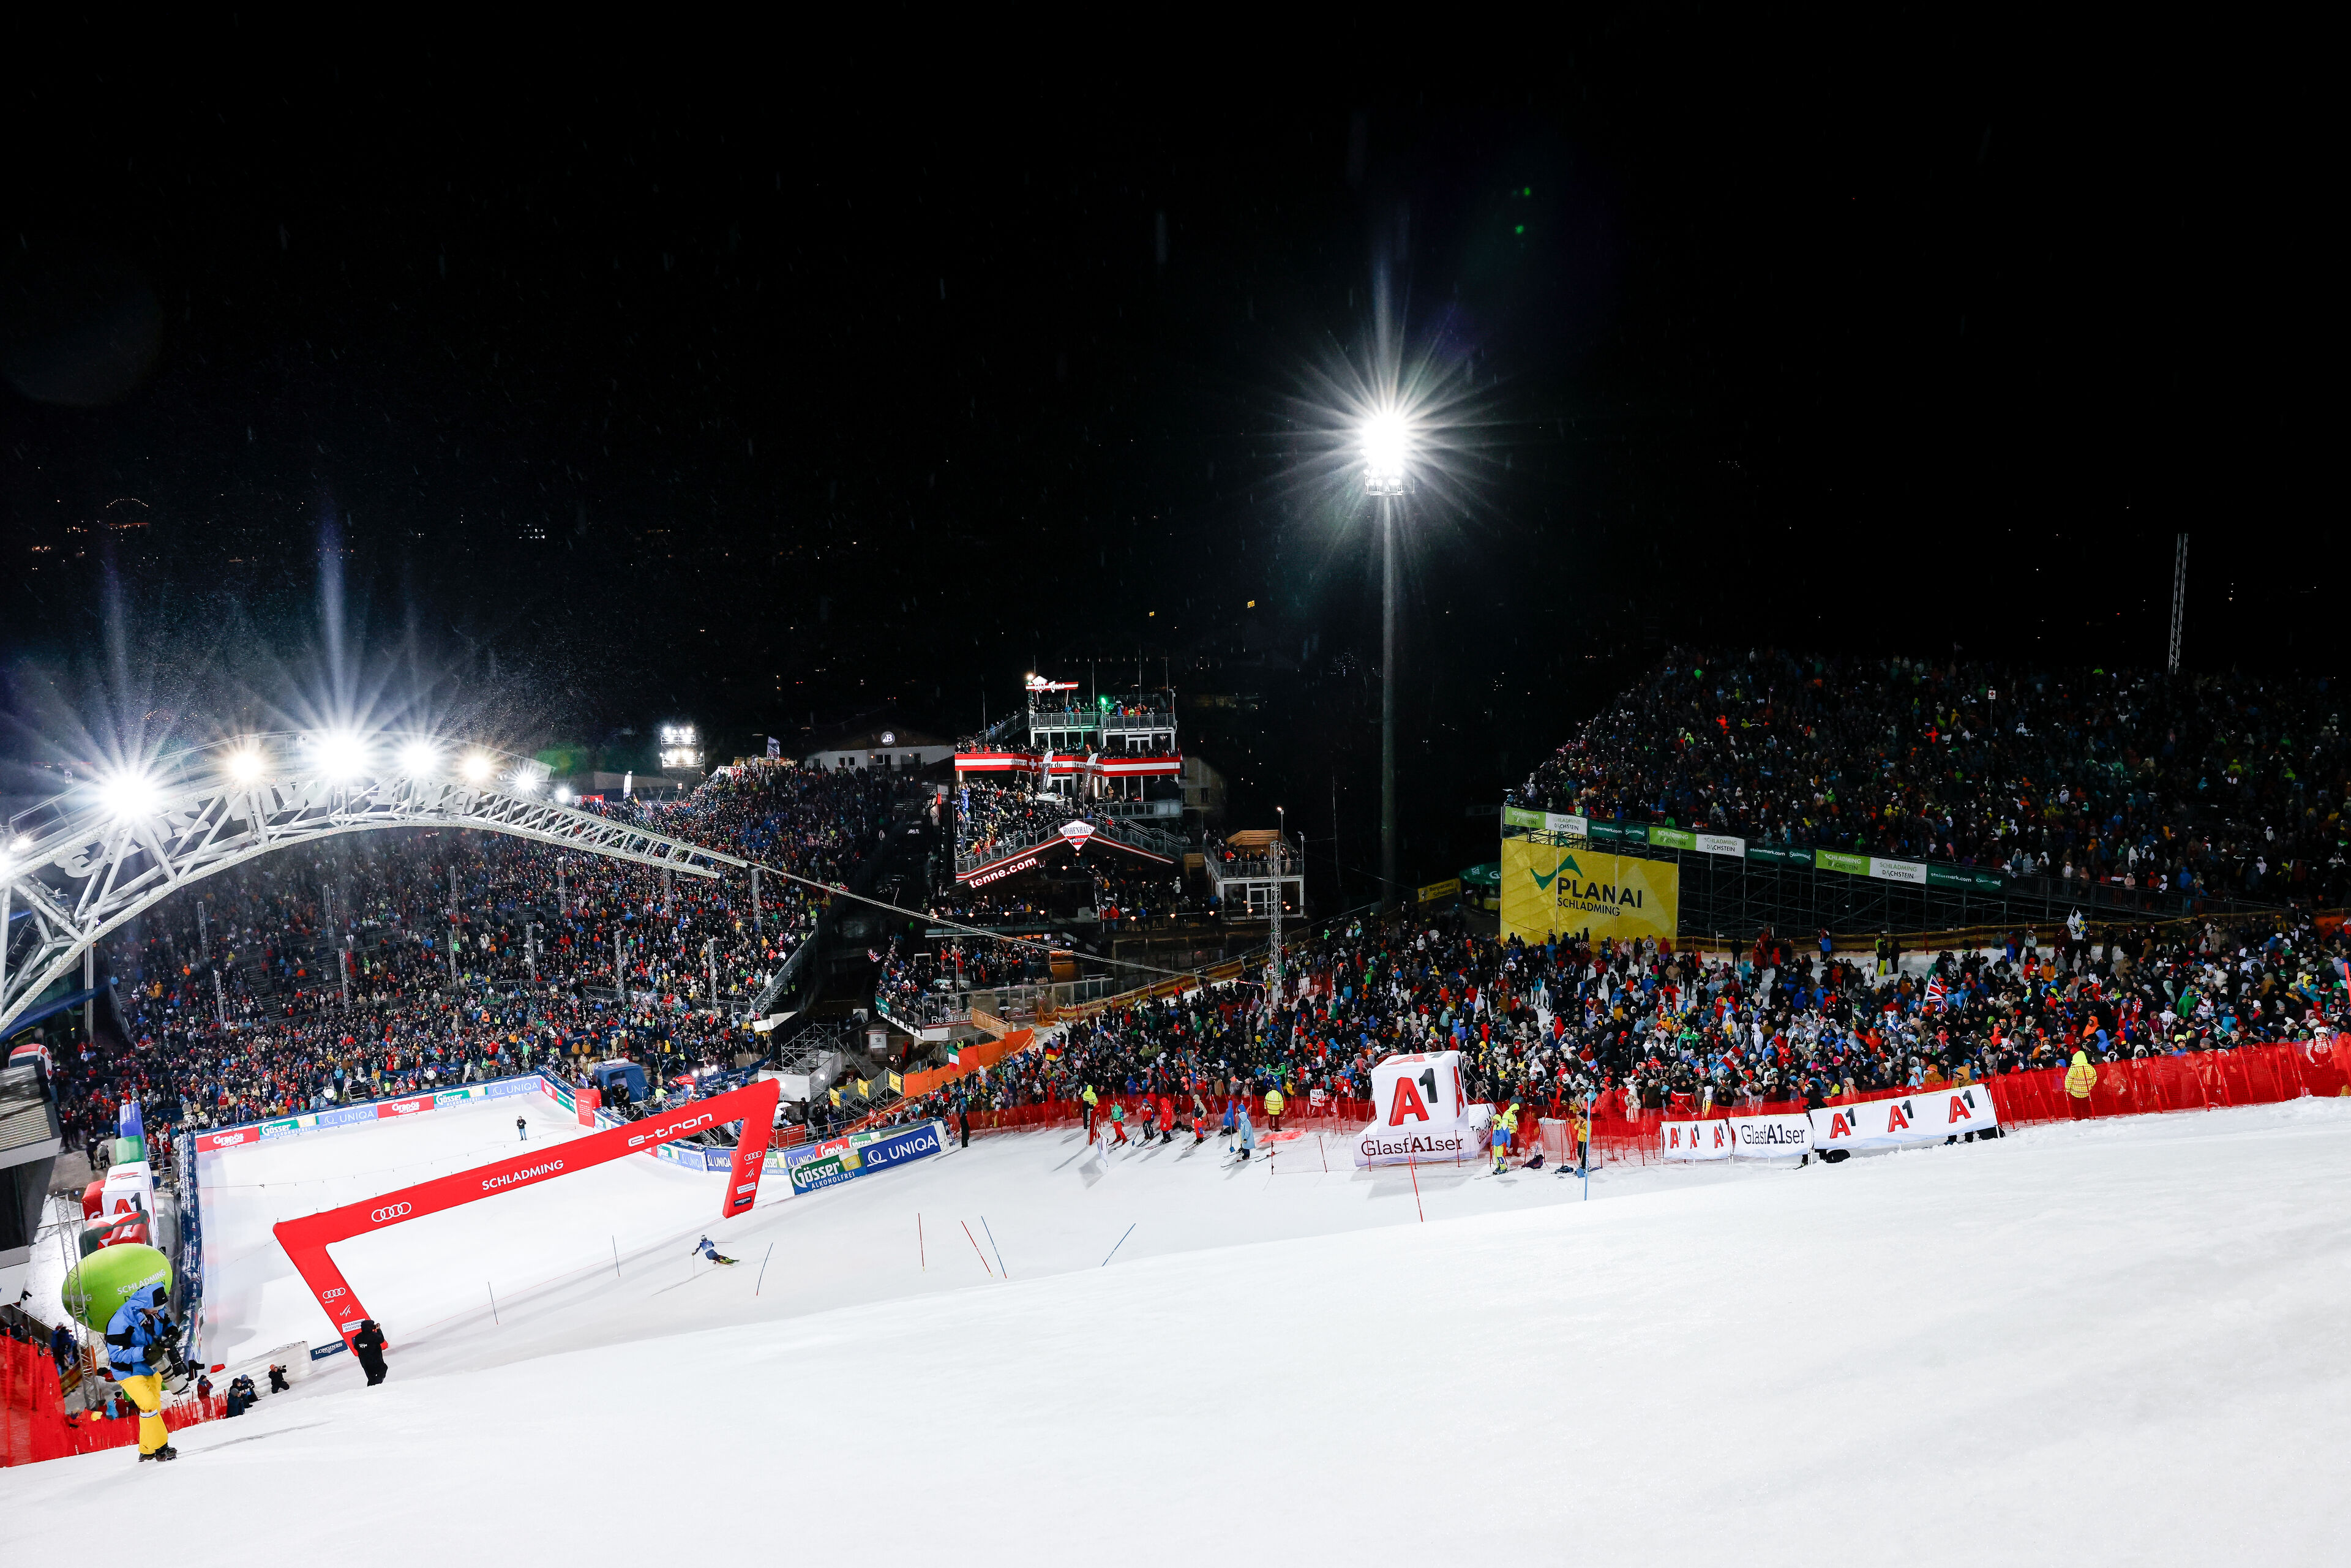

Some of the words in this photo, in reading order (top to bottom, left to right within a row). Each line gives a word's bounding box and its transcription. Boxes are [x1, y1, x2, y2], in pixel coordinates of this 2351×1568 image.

[1063, 826, 1092, 835] HOHENHAUS
[1657, 830, 1689, 840] SCHLADMING
[1704, 837, 1738, 846] SCHLADMING
[1825, 853, 1861, 864] SCHLADMING
[1828, 861, 1858, 871] DACHSTEIN
[1880, 862, 1917, 872] SCHLADMING
[969, 857, 1037, 889] tenne.com
[1882, 869, 1914, 879] DACHSTEIN
[1931, 873, 1971, 882] steiermark.com
[1558, 877, 1642, 908] PLANAI
[1557, 897, 1621, 917] SCHLADMING
[506, 1081, 539, 1093] UNIQA
[1389, 1068, 1438, 1126] A1
[436, 1094, 463, 1106] Gösser
[1949, 1090, 1976, 1123] A1
[339, 1109, 375, 1123] UNIQA
[1829, 1108, 1856, 1139] A1
[1888, 1100, 1914, 1133] A1
[261, 1123, 291, 1136] Gösser
[628, 1113, 713, 1147] e-tron
[1670, 1125, 1681, 1149] A1
[1690, 1123, 1700, 1149] A1
[1714, 1123, 1725, 1148] A1
[1741, 1123, 1805, 1145] GlasfA1ser
[888, 1135, 938, 1160] UNIQA
[1361, 1136, 1464, 1156] GlasfA1ser
[688, 1157, 703, 1168] UNIQA
[714, 1157, 732, 1168] UNIQA
[482, 1160, 564, 1190] SCHLADMING
[791, 1161, 841, 1188] Gösser
[811, 1171, 855, 1189] ALKOHOLFREI
[117, 1269, 166, 1295] SCHLADMING
[315, 1342, 343, 1354] LONGINES
